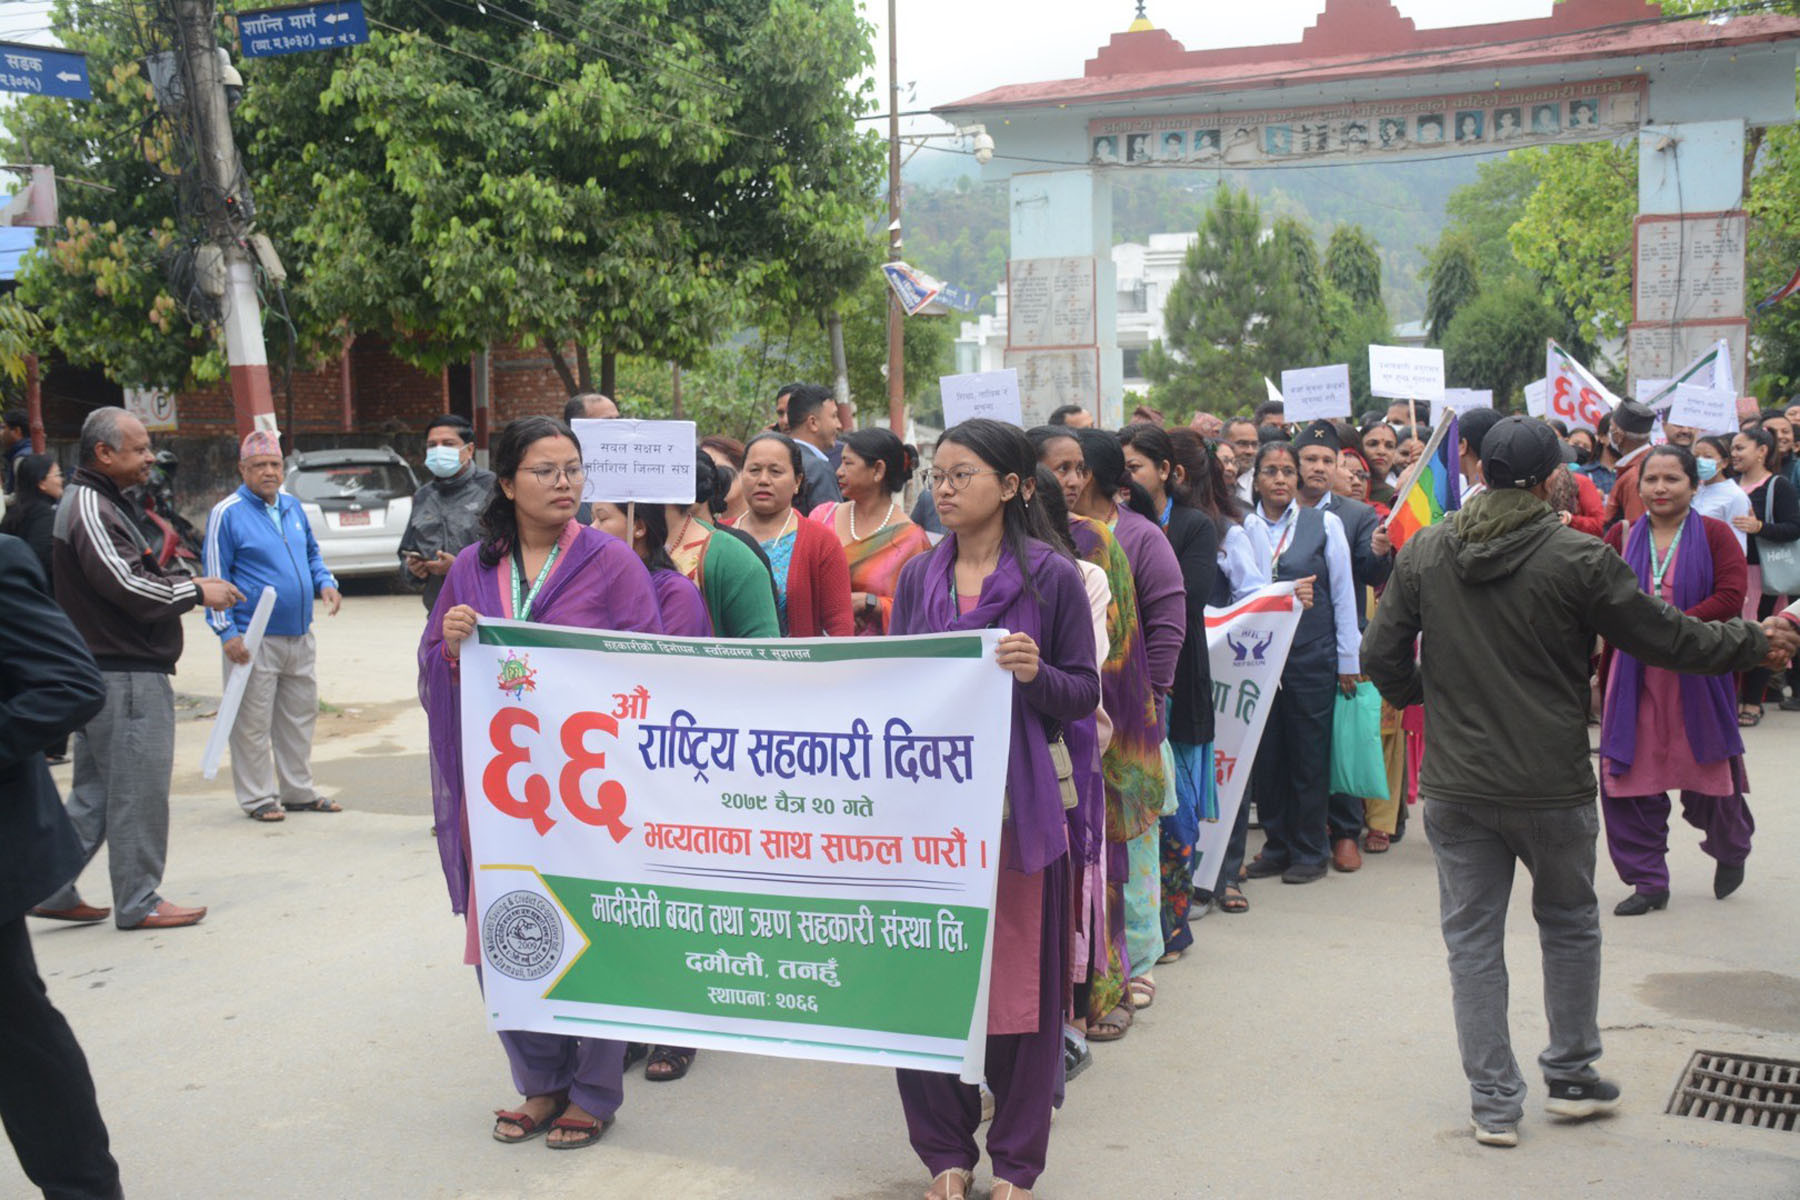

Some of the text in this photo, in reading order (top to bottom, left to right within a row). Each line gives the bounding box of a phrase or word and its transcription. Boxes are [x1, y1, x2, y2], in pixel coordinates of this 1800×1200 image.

[241, 8, 317, 36] शान्ति मार्ग
[4, 54, 43, 72] सडक
[633, 443, 661, 454] सक्षम
[667, 444, 674, 453] र
[633, 461, 665, 474] जिल्ला
[602, 640, 654, 652] सहकारीको
[757, 649, 768, 659] र
[770, 648, 811, 661] सुशासन
[638, 709, 974, 784] राष्ट्रिय सहकारी दिवस
[482, 707, 632, 844] ६६
[721, 790, 874, 818] २०७९ चैत्र २० गते
[643, 822, 752, 856] भव्यताका
[760, 829, 813, 860] साथ
[821, 833, 903, 864] सफल
[591, 886, 661, 929] मादीसेती
[665, 900, 704, 934] बचत
[708, 904, 744, 936] तथा
[749, 907, 792, 939] ऋण
[797, 905, 874, 945] सहकारी
[880, 909, 932, 950] संस्था
[937, 908, 969, 953] लि.
[517, 941, 537, 950] 2009
[778, 957, 841, 987] तनहुँ
[776, 993, 818, 1012] २०६६
